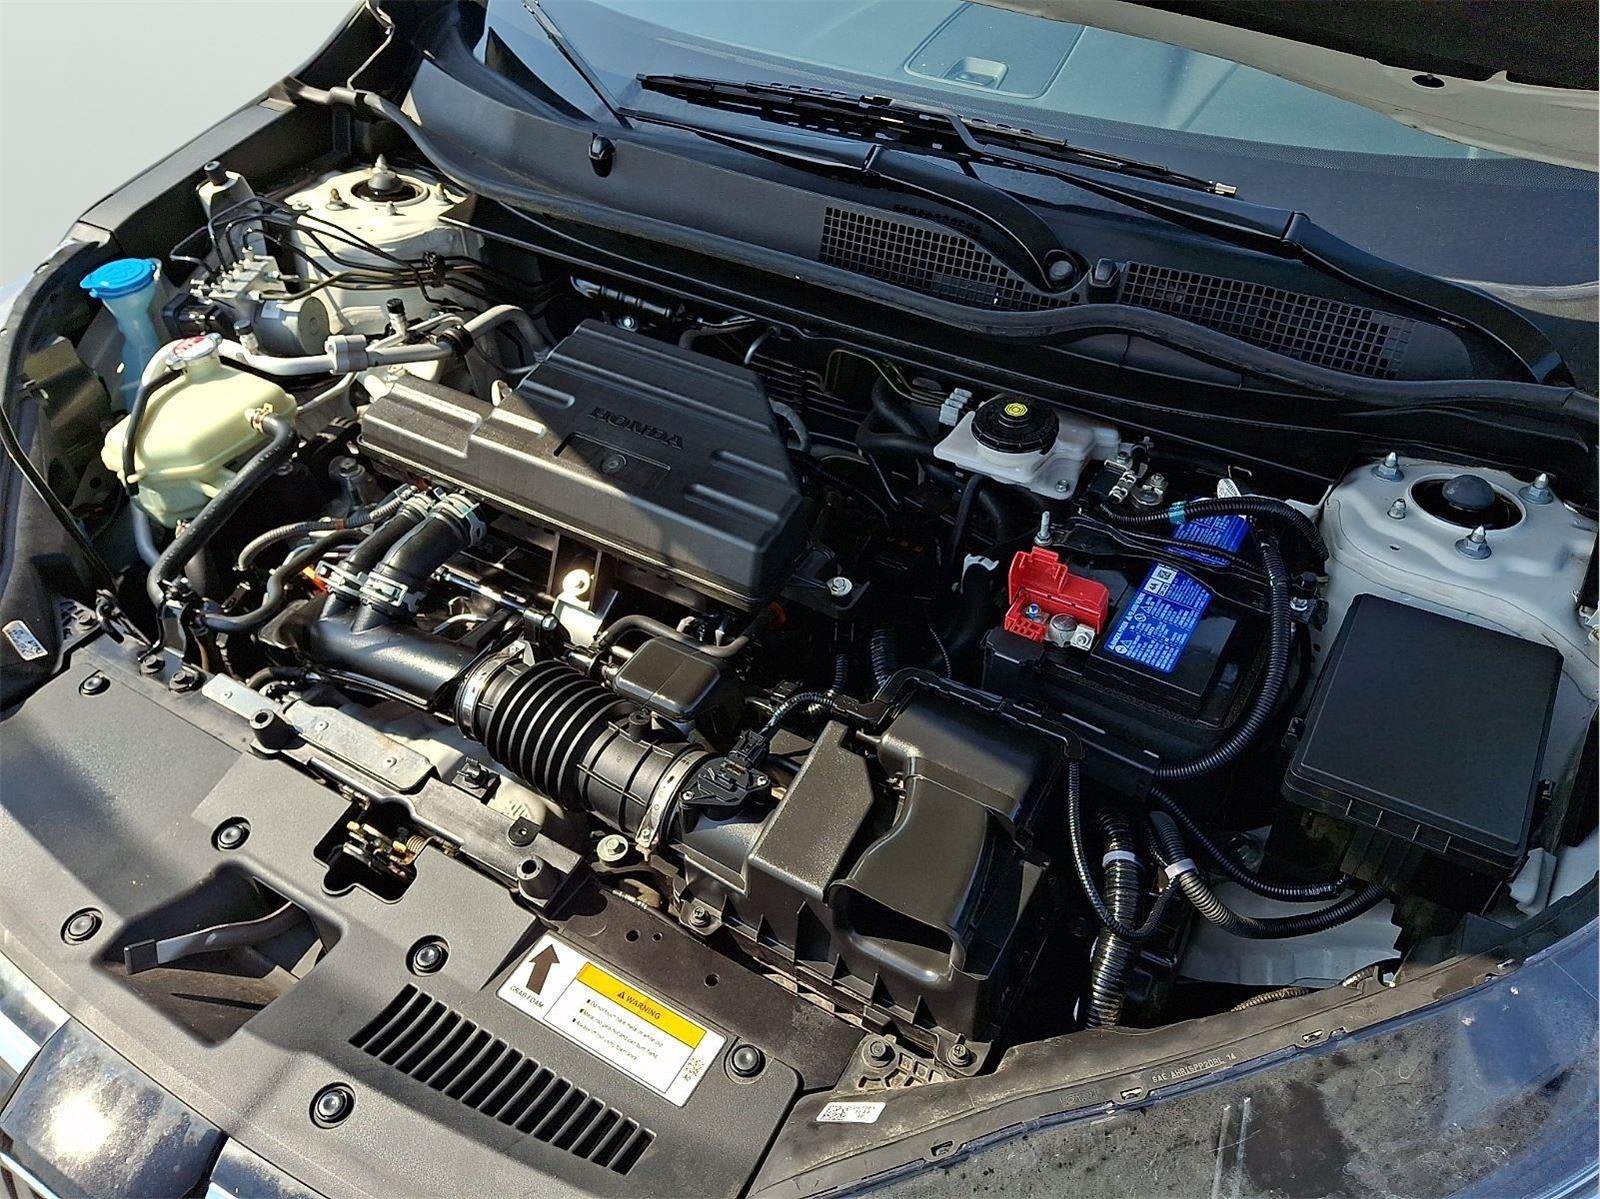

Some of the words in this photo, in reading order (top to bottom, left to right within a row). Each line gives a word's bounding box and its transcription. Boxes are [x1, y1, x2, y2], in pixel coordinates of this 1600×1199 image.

[587, 406, 683, 450] HONDA
[510, 985, 528, 999] GRAB
[526, 993, 545, 1009] FOAM
[626, 995, 662, 1020] WARNING
[1151, 1072, 1169, 1083] SAE
